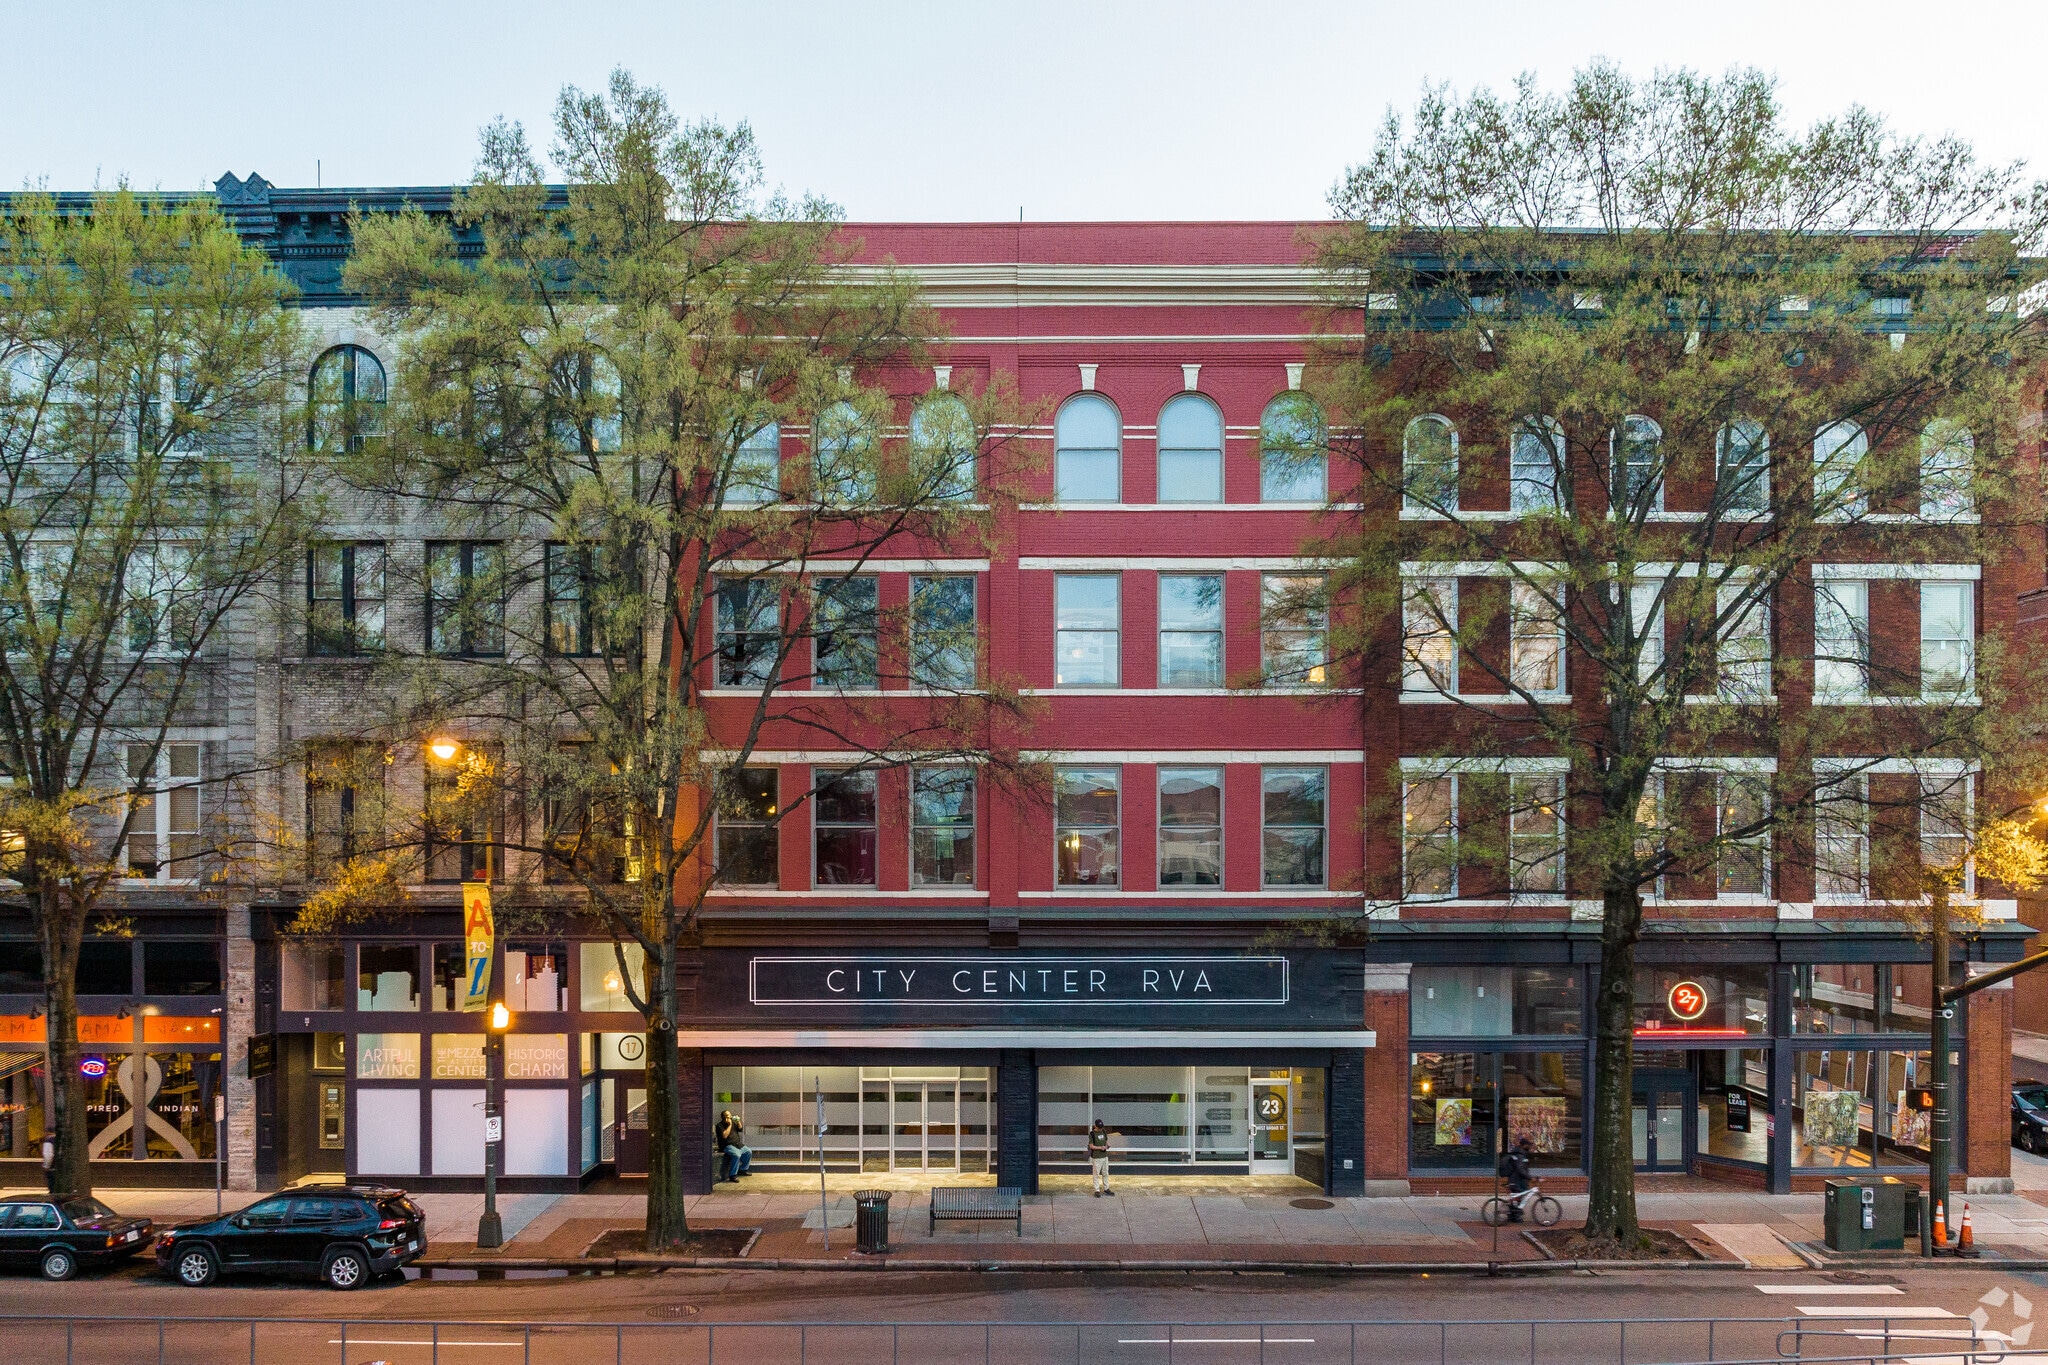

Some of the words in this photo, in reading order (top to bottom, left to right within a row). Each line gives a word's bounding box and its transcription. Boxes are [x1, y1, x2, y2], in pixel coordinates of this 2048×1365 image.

[466, 900, 492, 937] A
[470, 941, 487, 953] TO
[469, 957, 488, 996] Z
[826, 969, 916, 993] CITY
[952, 969, 1107, 993] CENTER
[1143, 969, 1212, 993] RVA
[1679, 989, 1699, 1012] 27
[81, 1023, 123, 1035] AMA
[625, 1042, 637, 1054] 17
[363, 1049, 415, 1062] ARTFUL
[508, 1049, 565, 1060] HISTORIC
[81, 1063, 105, 1073] OPEN
[362, 1064, 415, 1076] LIVING
[436, 1065, 486, 1076] CENTER
[508, 1063, 565, 1076] CHARM
[1262, 1100, 1279, 1114] 23
